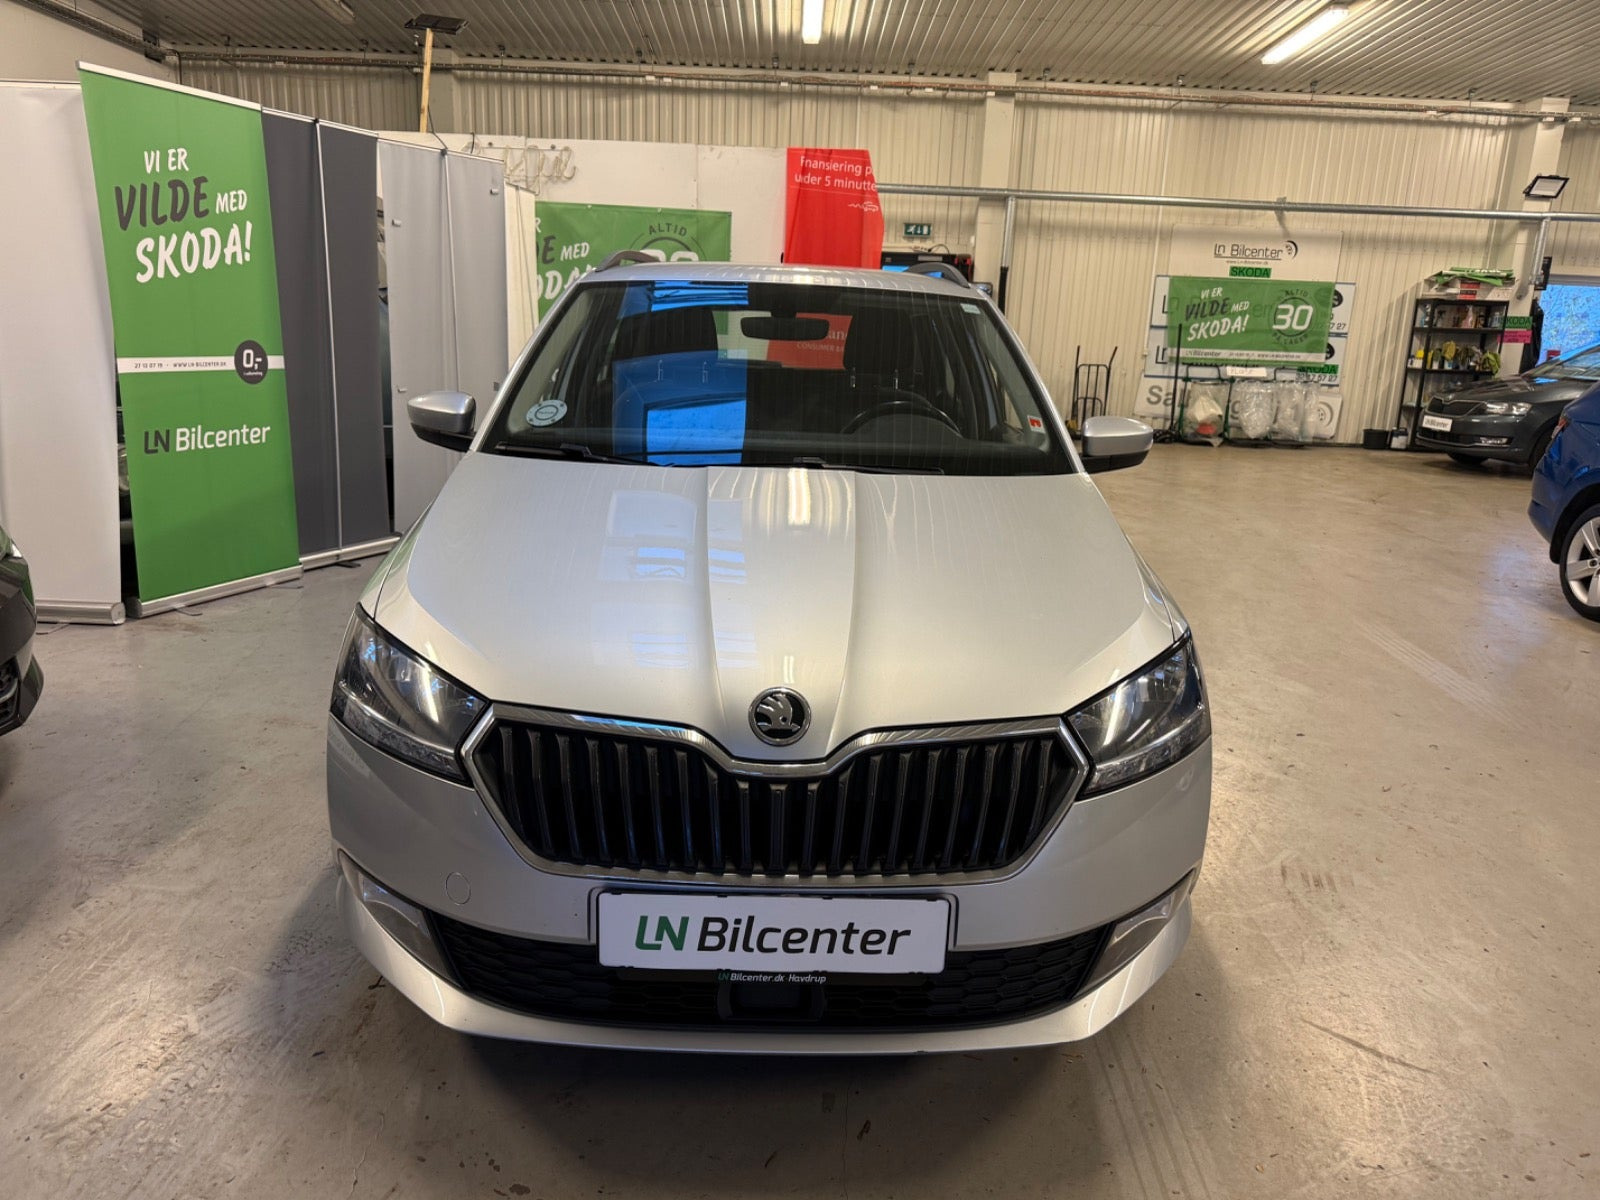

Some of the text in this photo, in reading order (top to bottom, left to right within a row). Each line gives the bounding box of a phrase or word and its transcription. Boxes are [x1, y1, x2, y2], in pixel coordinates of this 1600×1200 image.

[144, 147, 190, 174] VI ER
[824, 176, 832, 187] 5
[114, 176, 248, 232] VILDE MED
[649, 222, 688, 238] ALTID
[136, 220, 253, 283] SKODA!
[560, 242, 590, 261] MED
[1230, 244, 1284, 260] Bilcenter
[1230, 267, 1271, 278] SKODA
[1201, 287, 1223, 299] VI ER
[1185, 297, 1230, 322] VILDE
[1231, 301, 1250, 313] MED
[1272, 304, 1314, 331] 30
[1187, 313, 1250, 342] SKODA!
[144, 424, 272, 455] LN Bilcenter
[635, 915, 912, 956] LN Bilcenter
[788, 974, 827, 985] Havdrup
